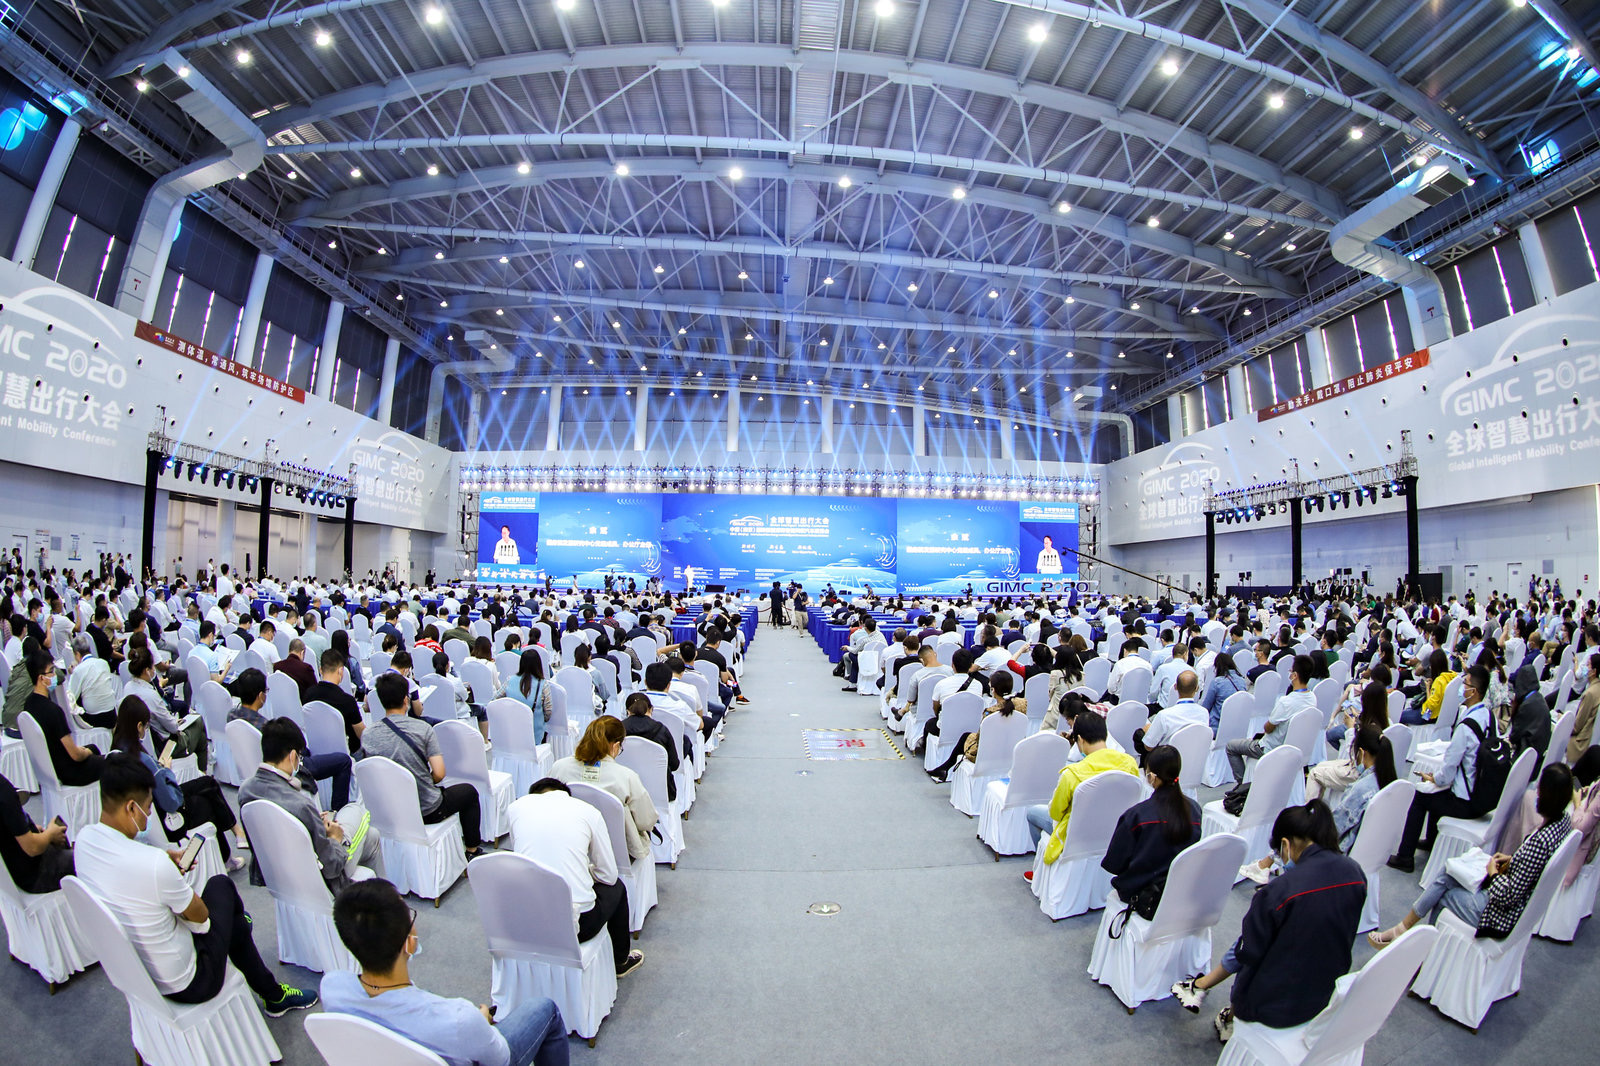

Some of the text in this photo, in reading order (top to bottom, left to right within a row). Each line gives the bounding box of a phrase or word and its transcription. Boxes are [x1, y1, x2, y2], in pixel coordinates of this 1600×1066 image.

[46, 340, 127, 389] 2020
[1454, 354, 1600, 416] GIMC 202
[18, 417, 58, 437] Mobility
[63, 428, 117, 446] Conference
[352, 449, 425, 483] GIMC 2020
[1448, 459, 1475, 472] Global
[1476, 450, 1522, 467] Intelligent
[1526, 443, 1565, 458] Mobility
[1143, 466, 1220, 496] GIMC 2020
[986, 582, 1032, 593] GIMC
